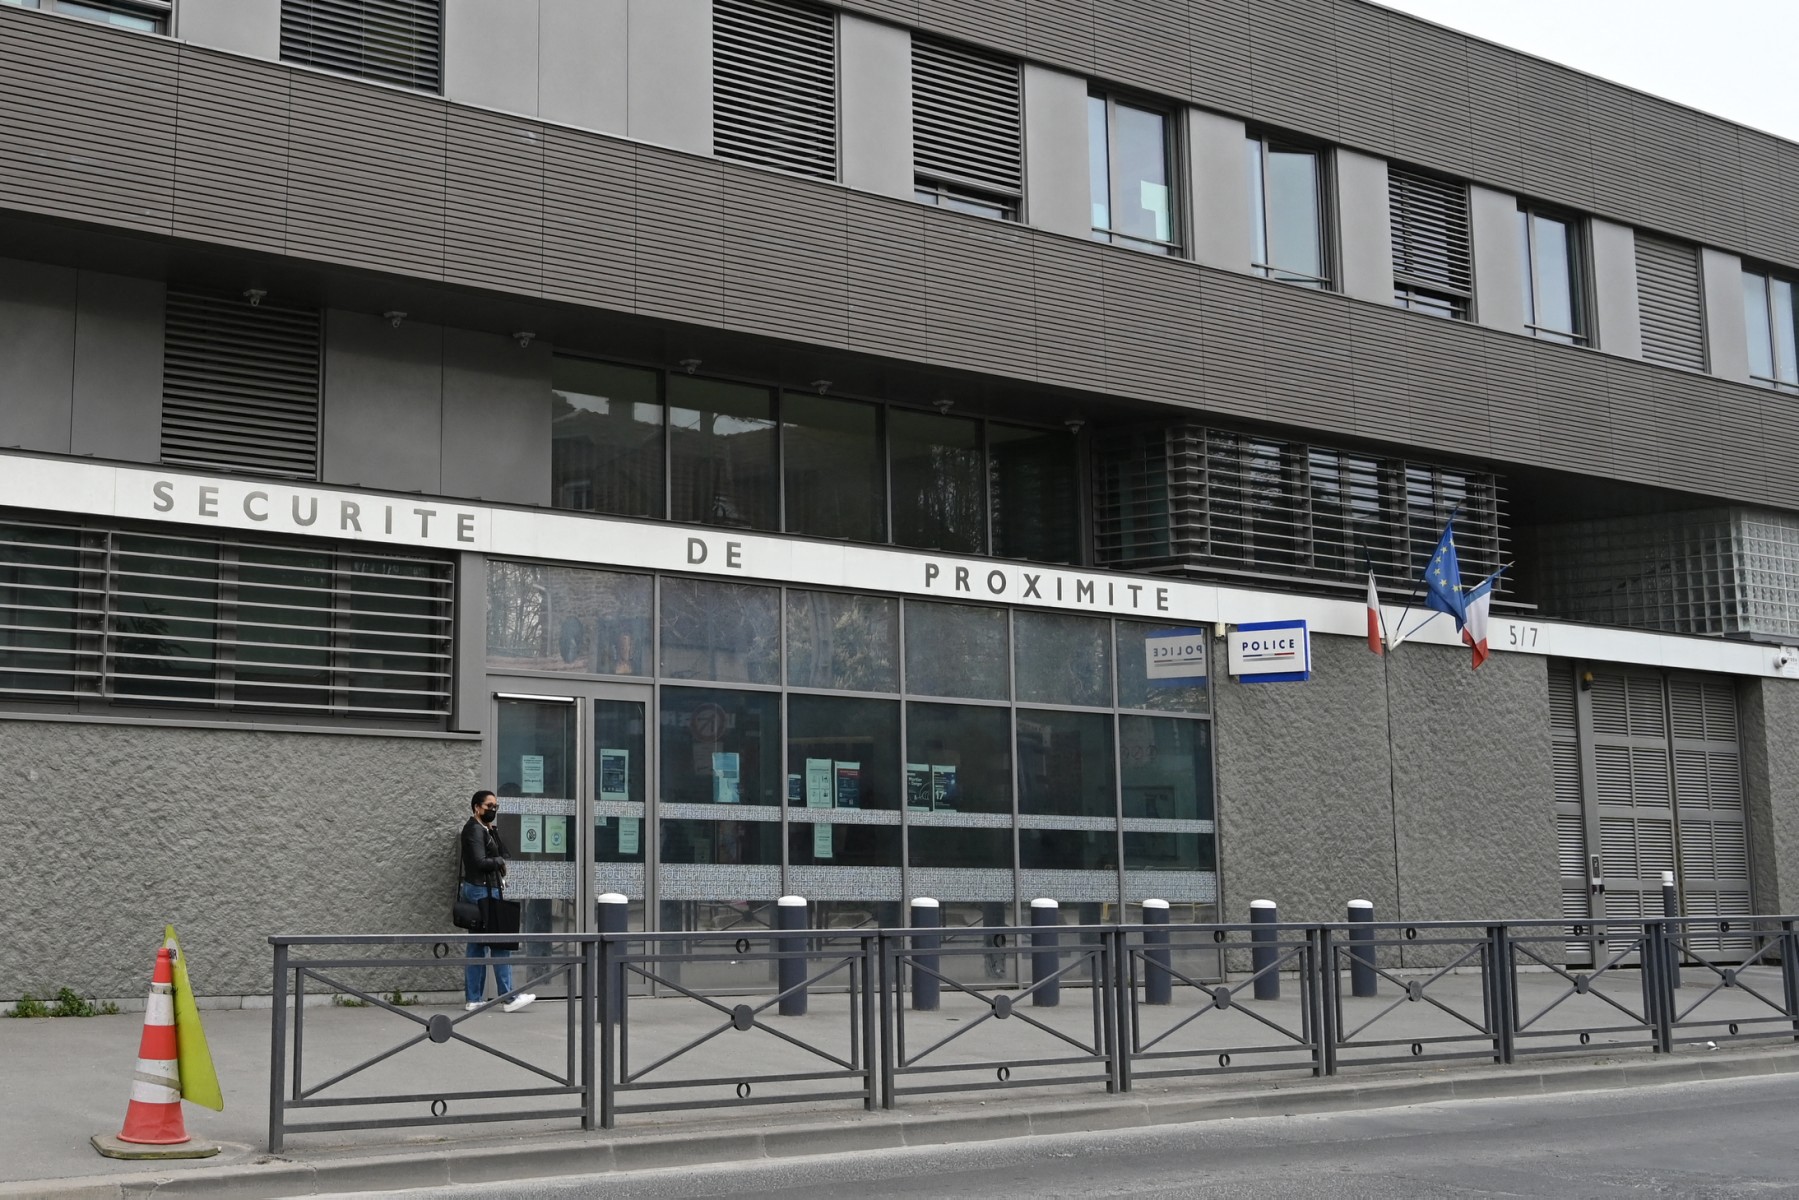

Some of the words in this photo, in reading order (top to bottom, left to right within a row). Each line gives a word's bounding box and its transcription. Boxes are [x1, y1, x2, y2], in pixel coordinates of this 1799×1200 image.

[153, 481, 475, 542] SECURITE
[687, 537, 742, 569] DE
[925, 563, 1169, 611] PROXIMITE
[1242, 639, 1295, 651] POLICE
[1510, 625, 1538, 647] 5/7
